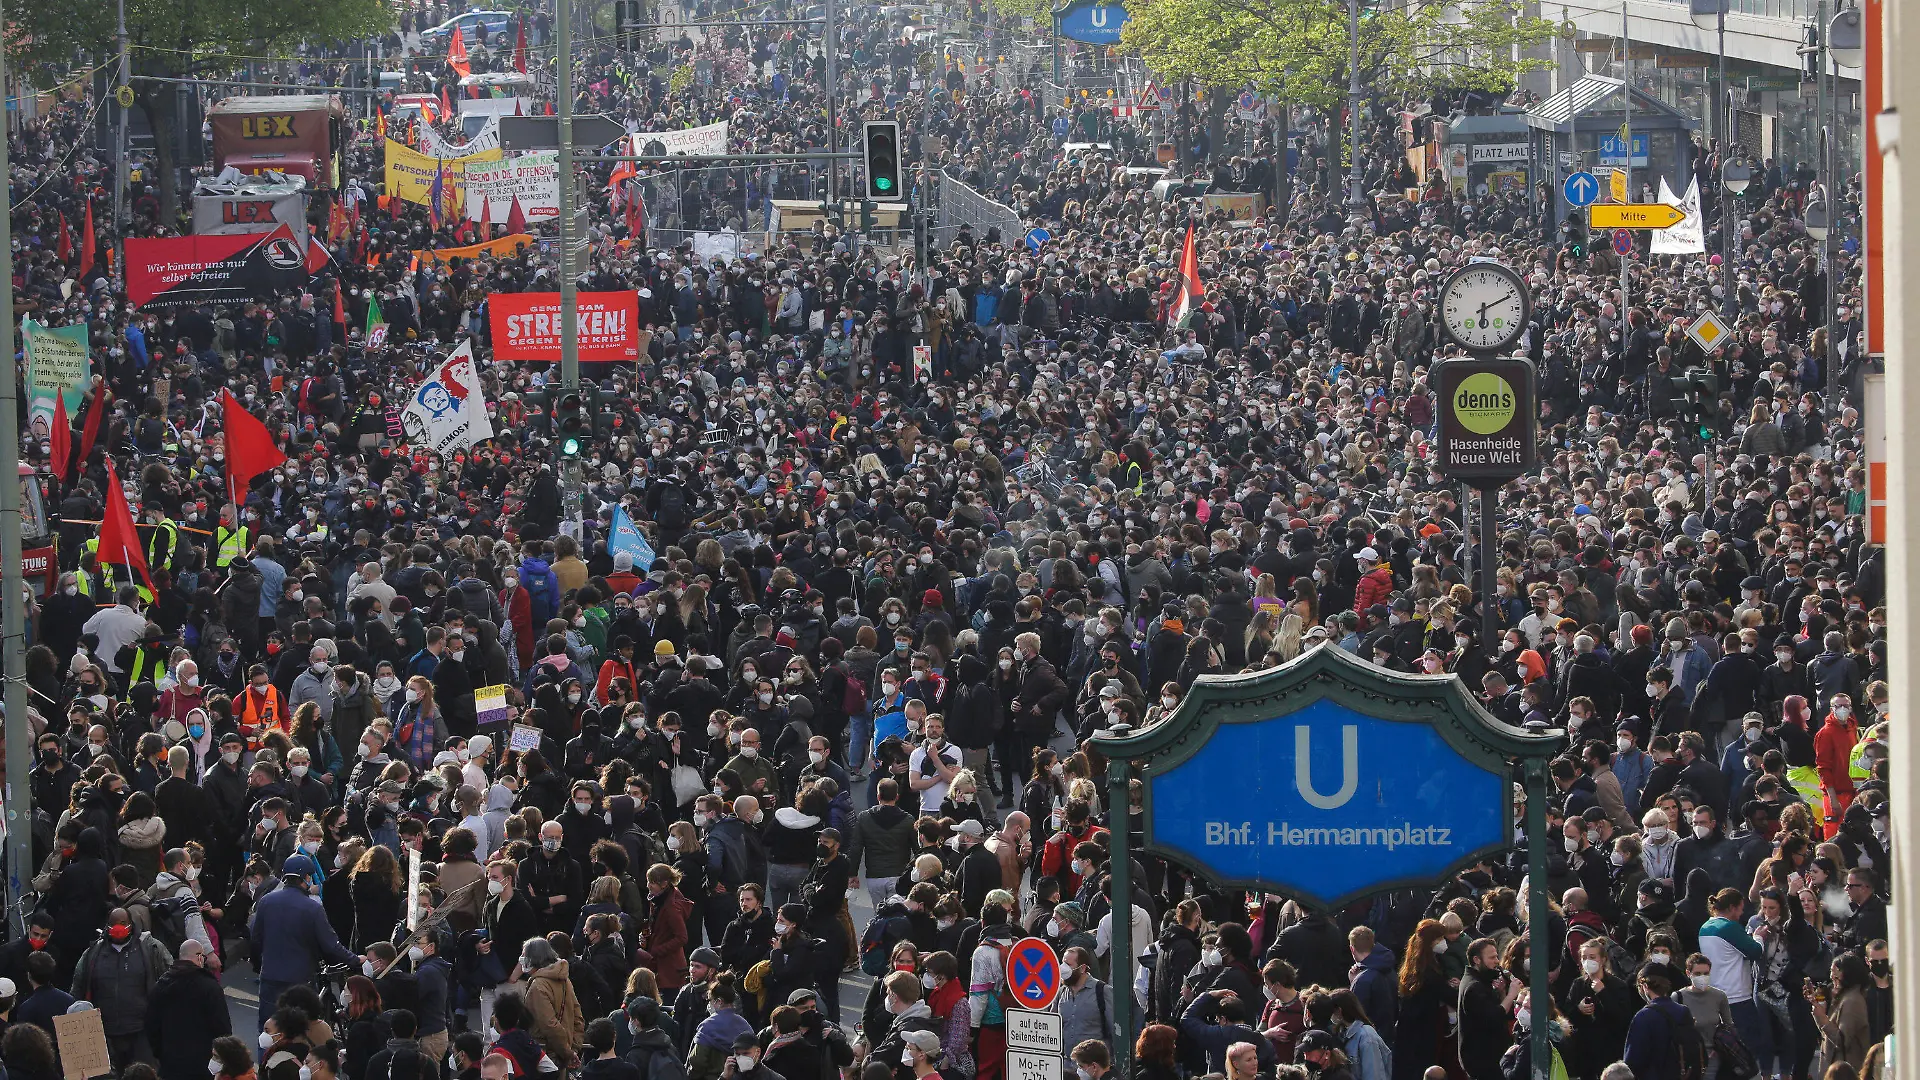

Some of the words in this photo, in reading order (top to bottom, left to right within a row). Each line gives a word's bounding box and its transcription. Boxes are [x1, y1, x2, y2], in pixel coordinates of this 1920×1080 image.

[242, 116, 294, 138] LEX
[1474, 148, 1503, 158] PLATZ
[516, 164, 555, 178] OFFENSIVE
[222, 201, 278, 224] LEX
[1620, 212, 1647, 221] Mitte
[147, 263, 166, 273] Wir
[167, 261, 202, 271] können
[205, 261, 224, 269] uns
[227, 260, 247, 268] nur
[162, 272, 188, 283] selbst
[190, 271, 230, 282] befreien
[506, 308, 627, 339] STREKEN!
[508, 337, 553, 346] GEGEN
[1449, 437, 1521, 450] Hasenheide
[1450, 451, 1486, 464] Neue
[1489, 450, 1521, 464] Welt
[1294, 724, 1359, 810] U
[1205, 821, 1255, 846] Bhf.
[1267, 821, 1452, 851] Hermannplatz
[1019, 1018, 1031, 1029] auf
[1033, 1019, 1049, 1031] dem
[1010, 1029, 1058, 1046] Seitenstreifen
[1018, 1057, 1050, 1072] Mo-Fr
